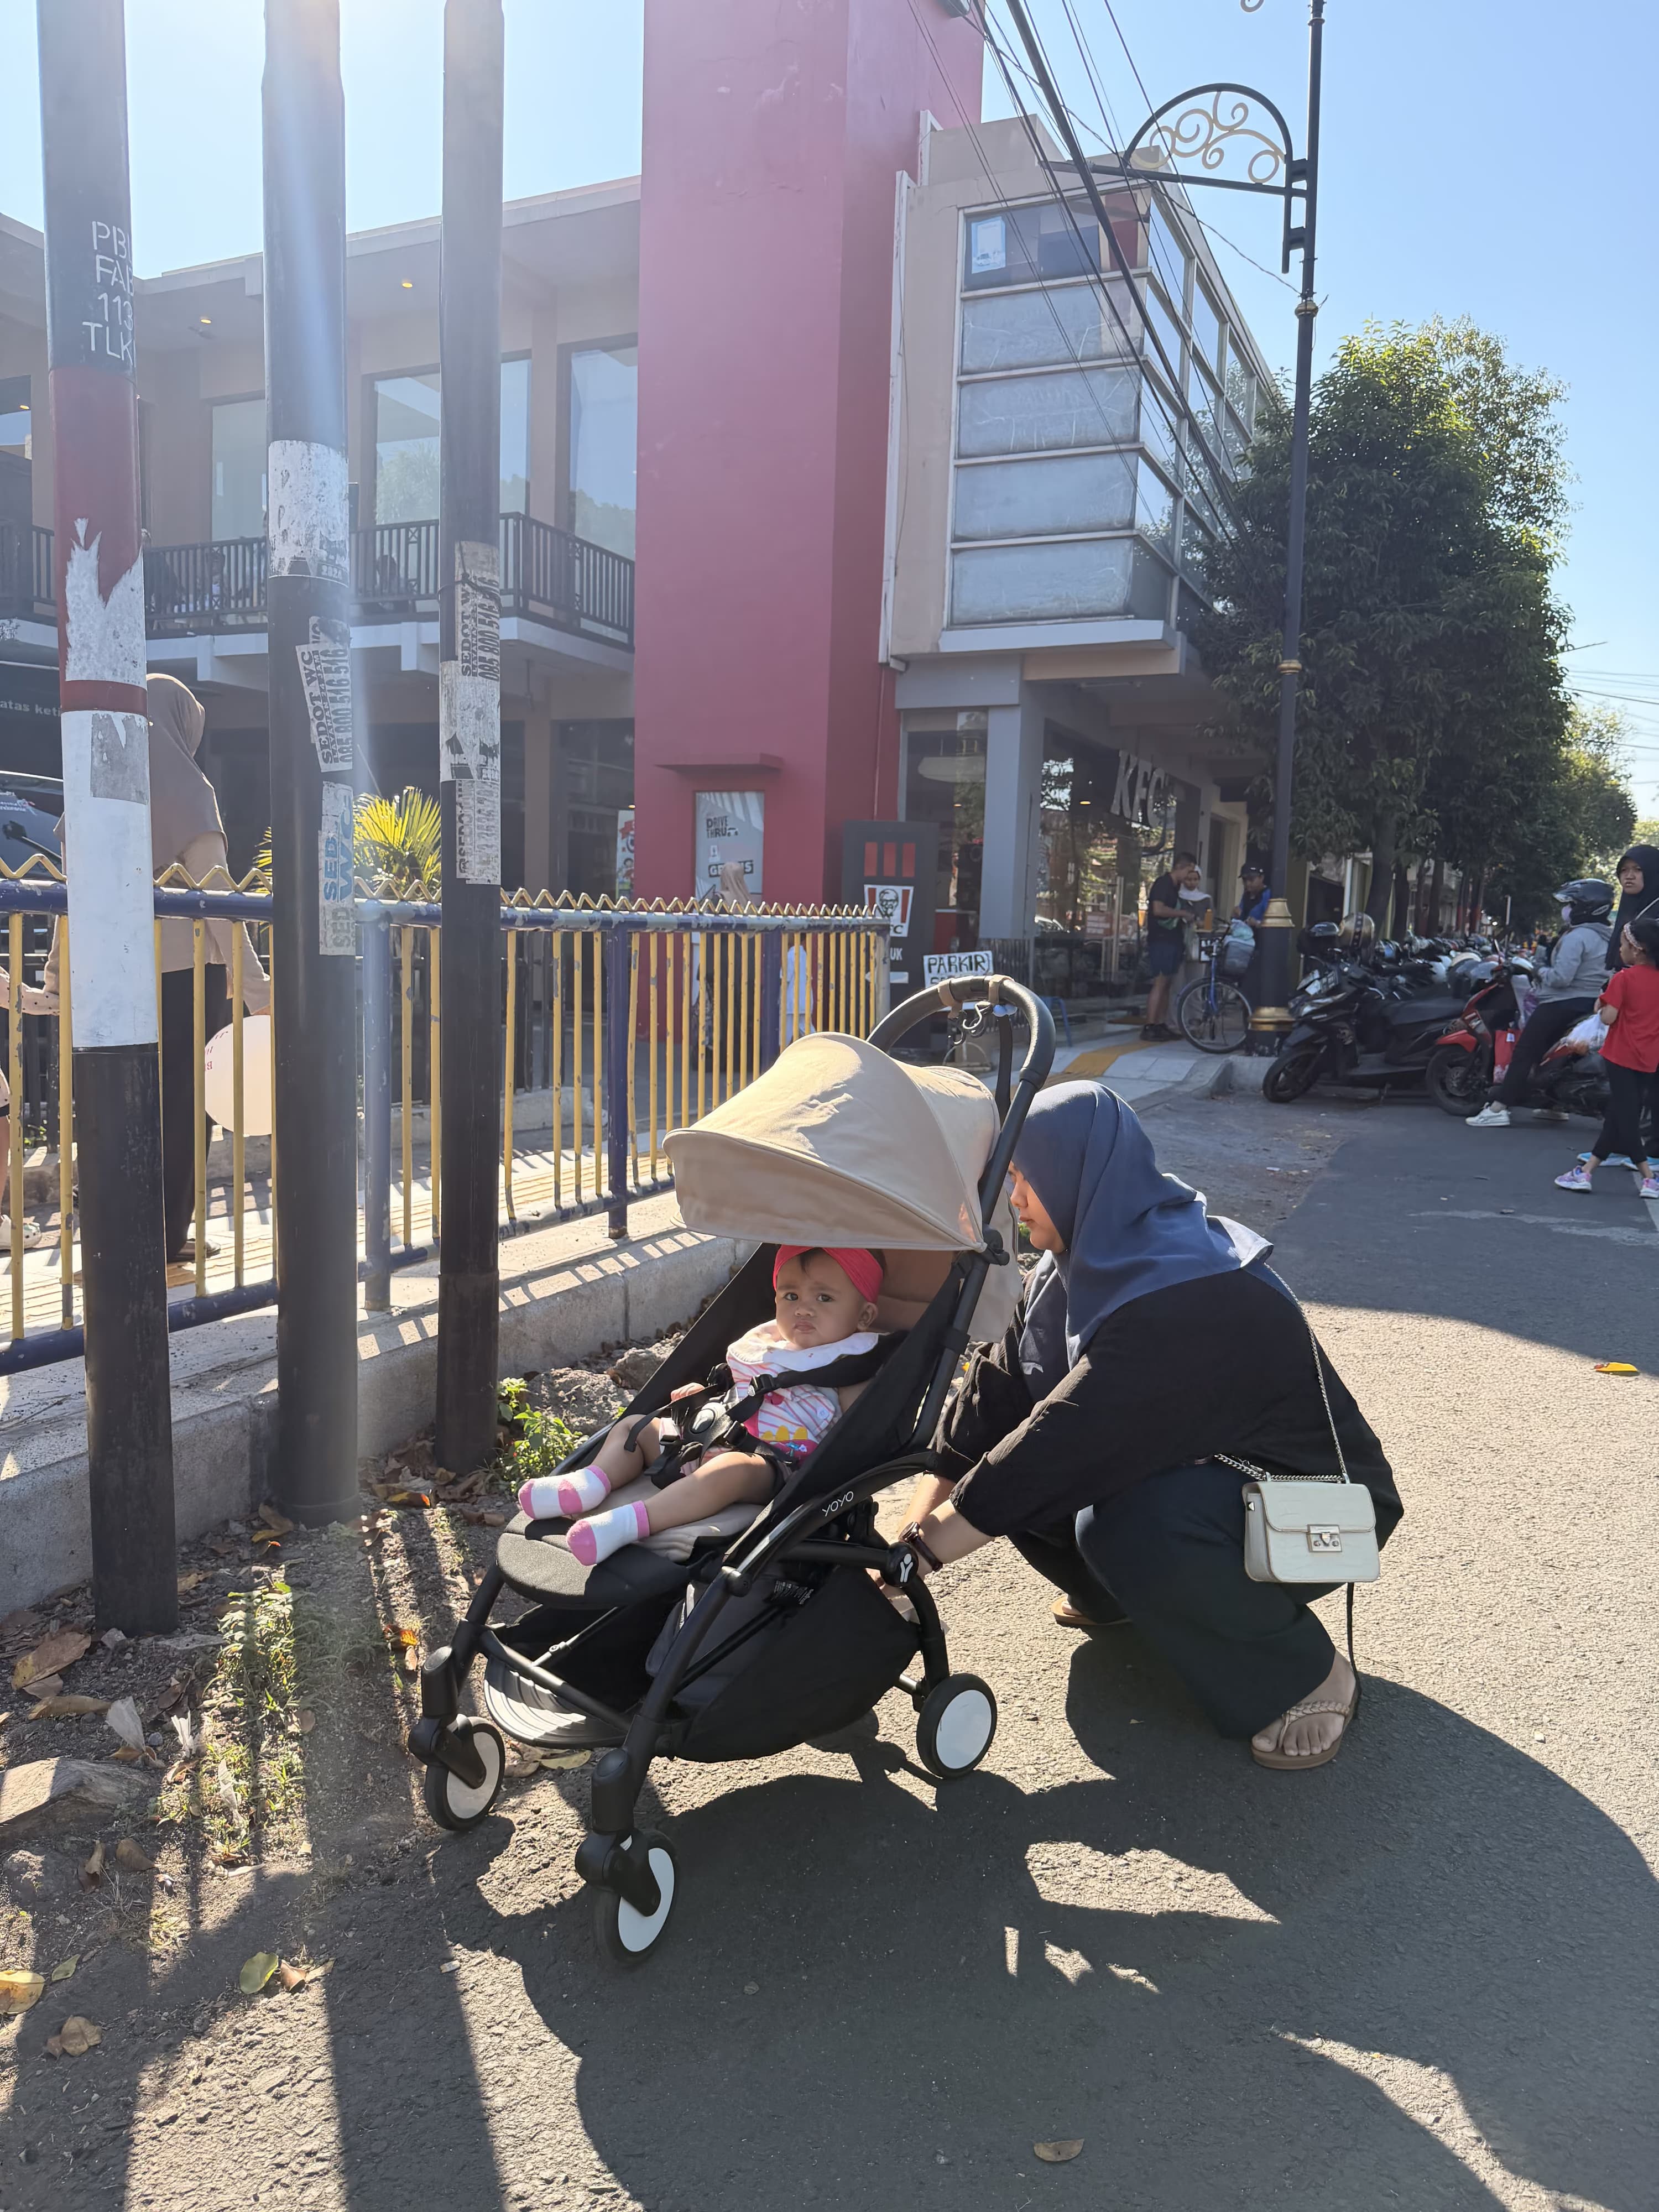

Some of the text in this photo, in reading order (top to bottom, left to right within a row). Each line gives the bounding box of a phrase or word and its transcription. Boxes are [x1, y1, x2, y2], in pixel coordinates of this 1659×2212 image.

[98, 293, 133, 331] 113
[461, 611, 471, 676] SEDOT
[478, 630, 500, 656] 800
[301, 651, 317, 686] WC
[315, 654, 325, 679] JAM
[320, 649, 350, 674] 516
[478, 656, 500, 682] 085
[325, 679, 351, 704] 516
[309, 692, 333, 764] SEDOT
[1110, 750, 1165, 830] KFC
[707, 816, 728, 828] DRIVE
[707, 828, 727, 838] THRU
[340, 794, 353, 901] WC
[927, 954, 986, 973] PARKIR
[822, 1491, 854, 1517] YOYO
